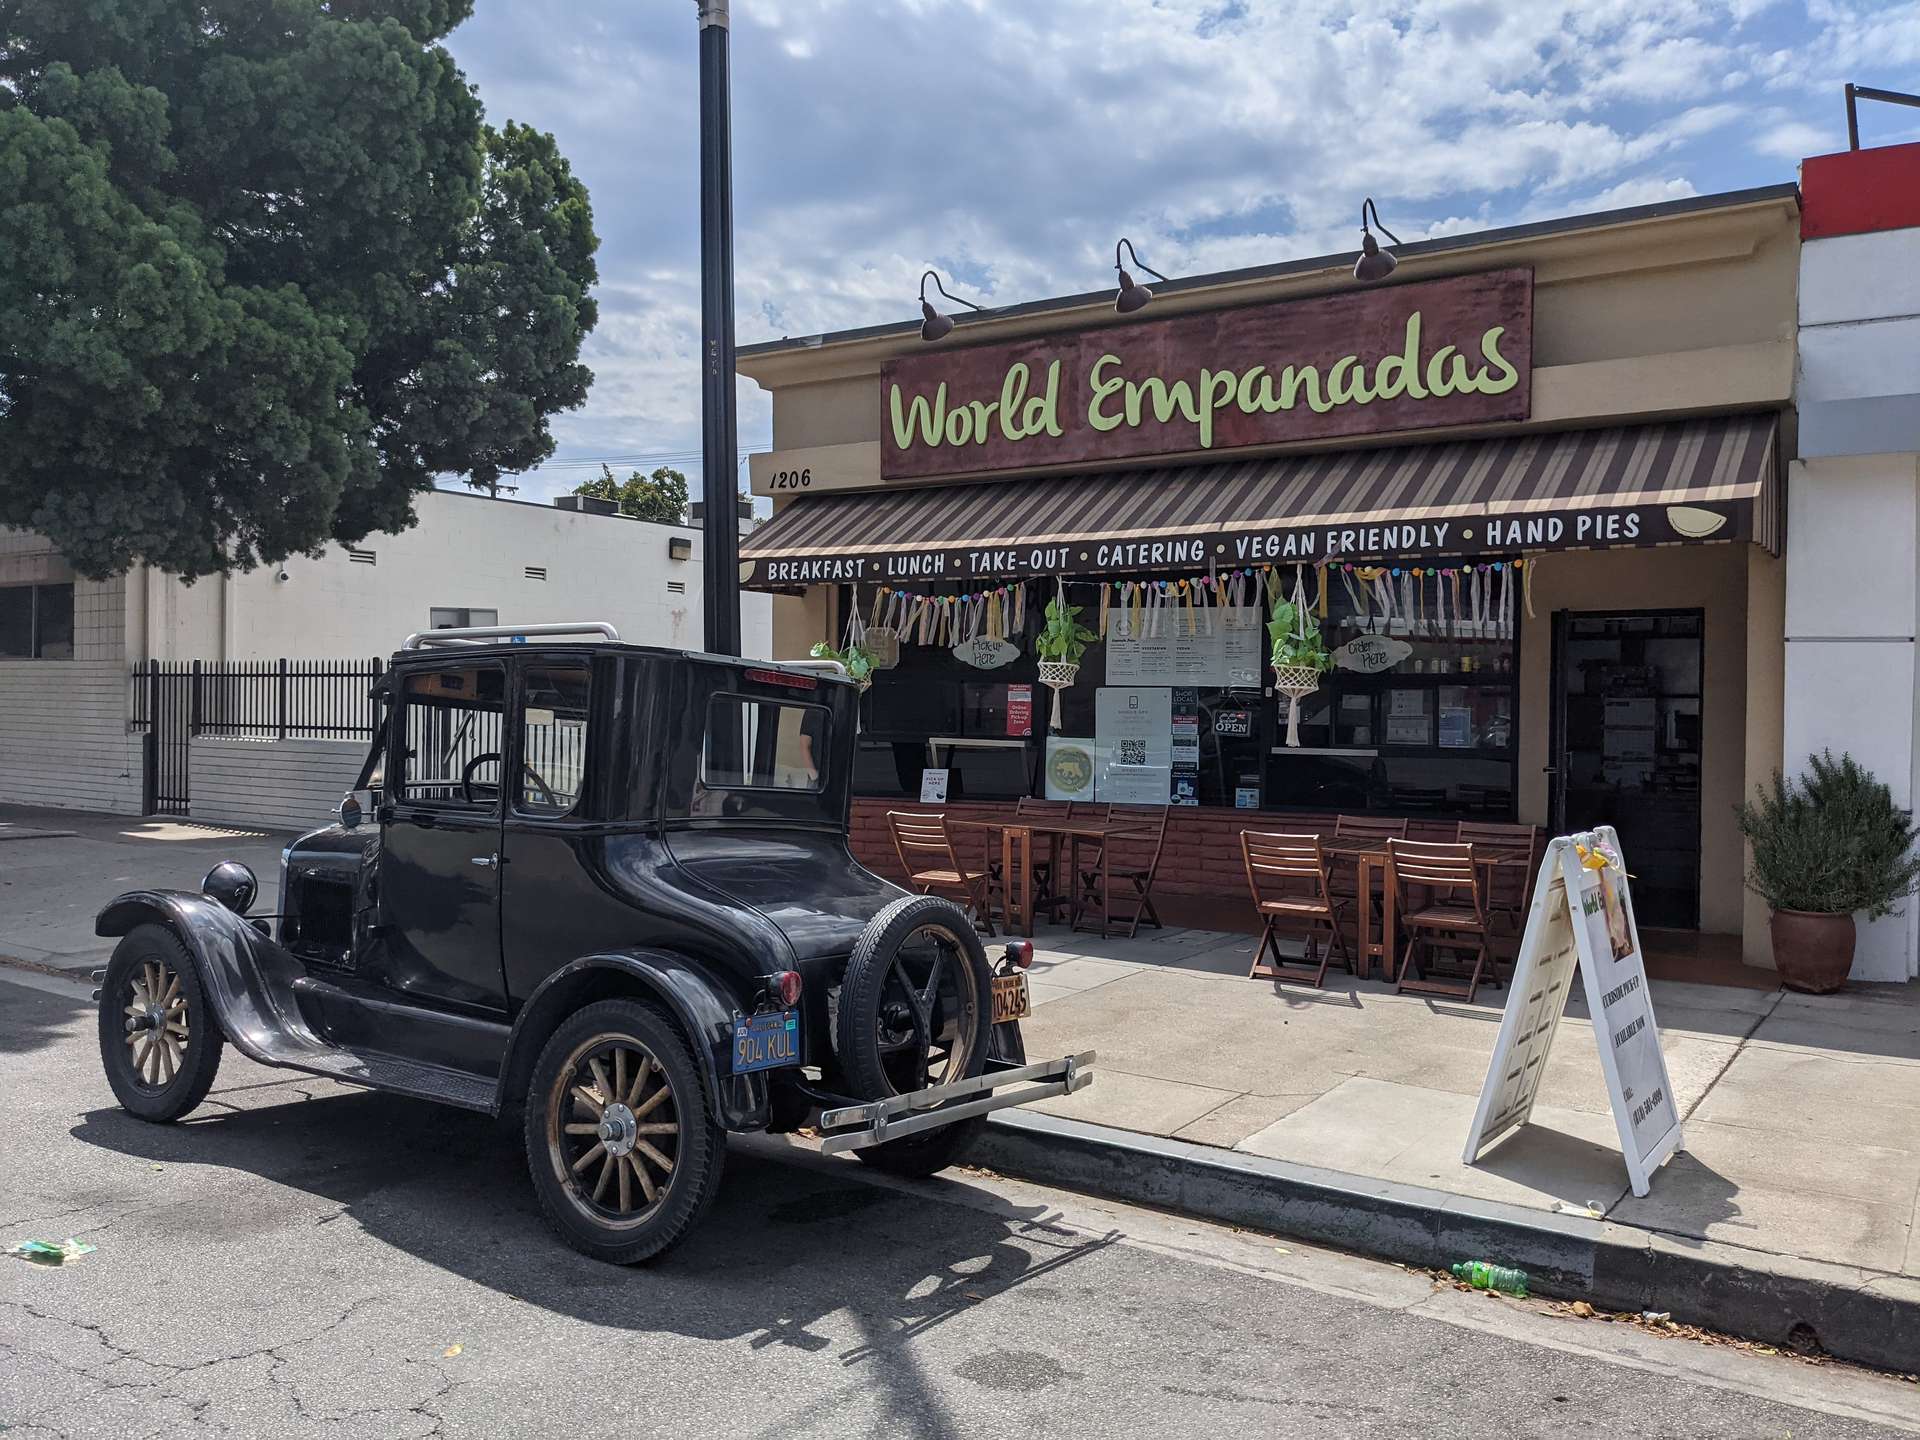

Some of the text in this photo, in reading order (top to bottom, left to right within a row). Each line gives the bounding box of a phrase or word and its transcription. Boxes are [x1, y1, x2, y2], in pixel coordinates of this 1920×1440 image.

[890, 311, 1519, 450] World Empanadas
[769, 468, 812, 490] 1206
[768, 512, 1640, 581] BREAKFAST LUNCH TAKE-OUT CATERING VEGAN FRIENDLY HAND PIES
[974, 652, 996, 666] Here
[1348, 640, 1374, 655] Order
[1361, 651, 1387, 669] Here
[1215, 722, 1247, 733] OPEN
[991, 988, 1027, 1018] 104245
[1614, 1020, 1637, 1048] AVAILABLE
[738, 1031, 796, 1066] 904 KUL
